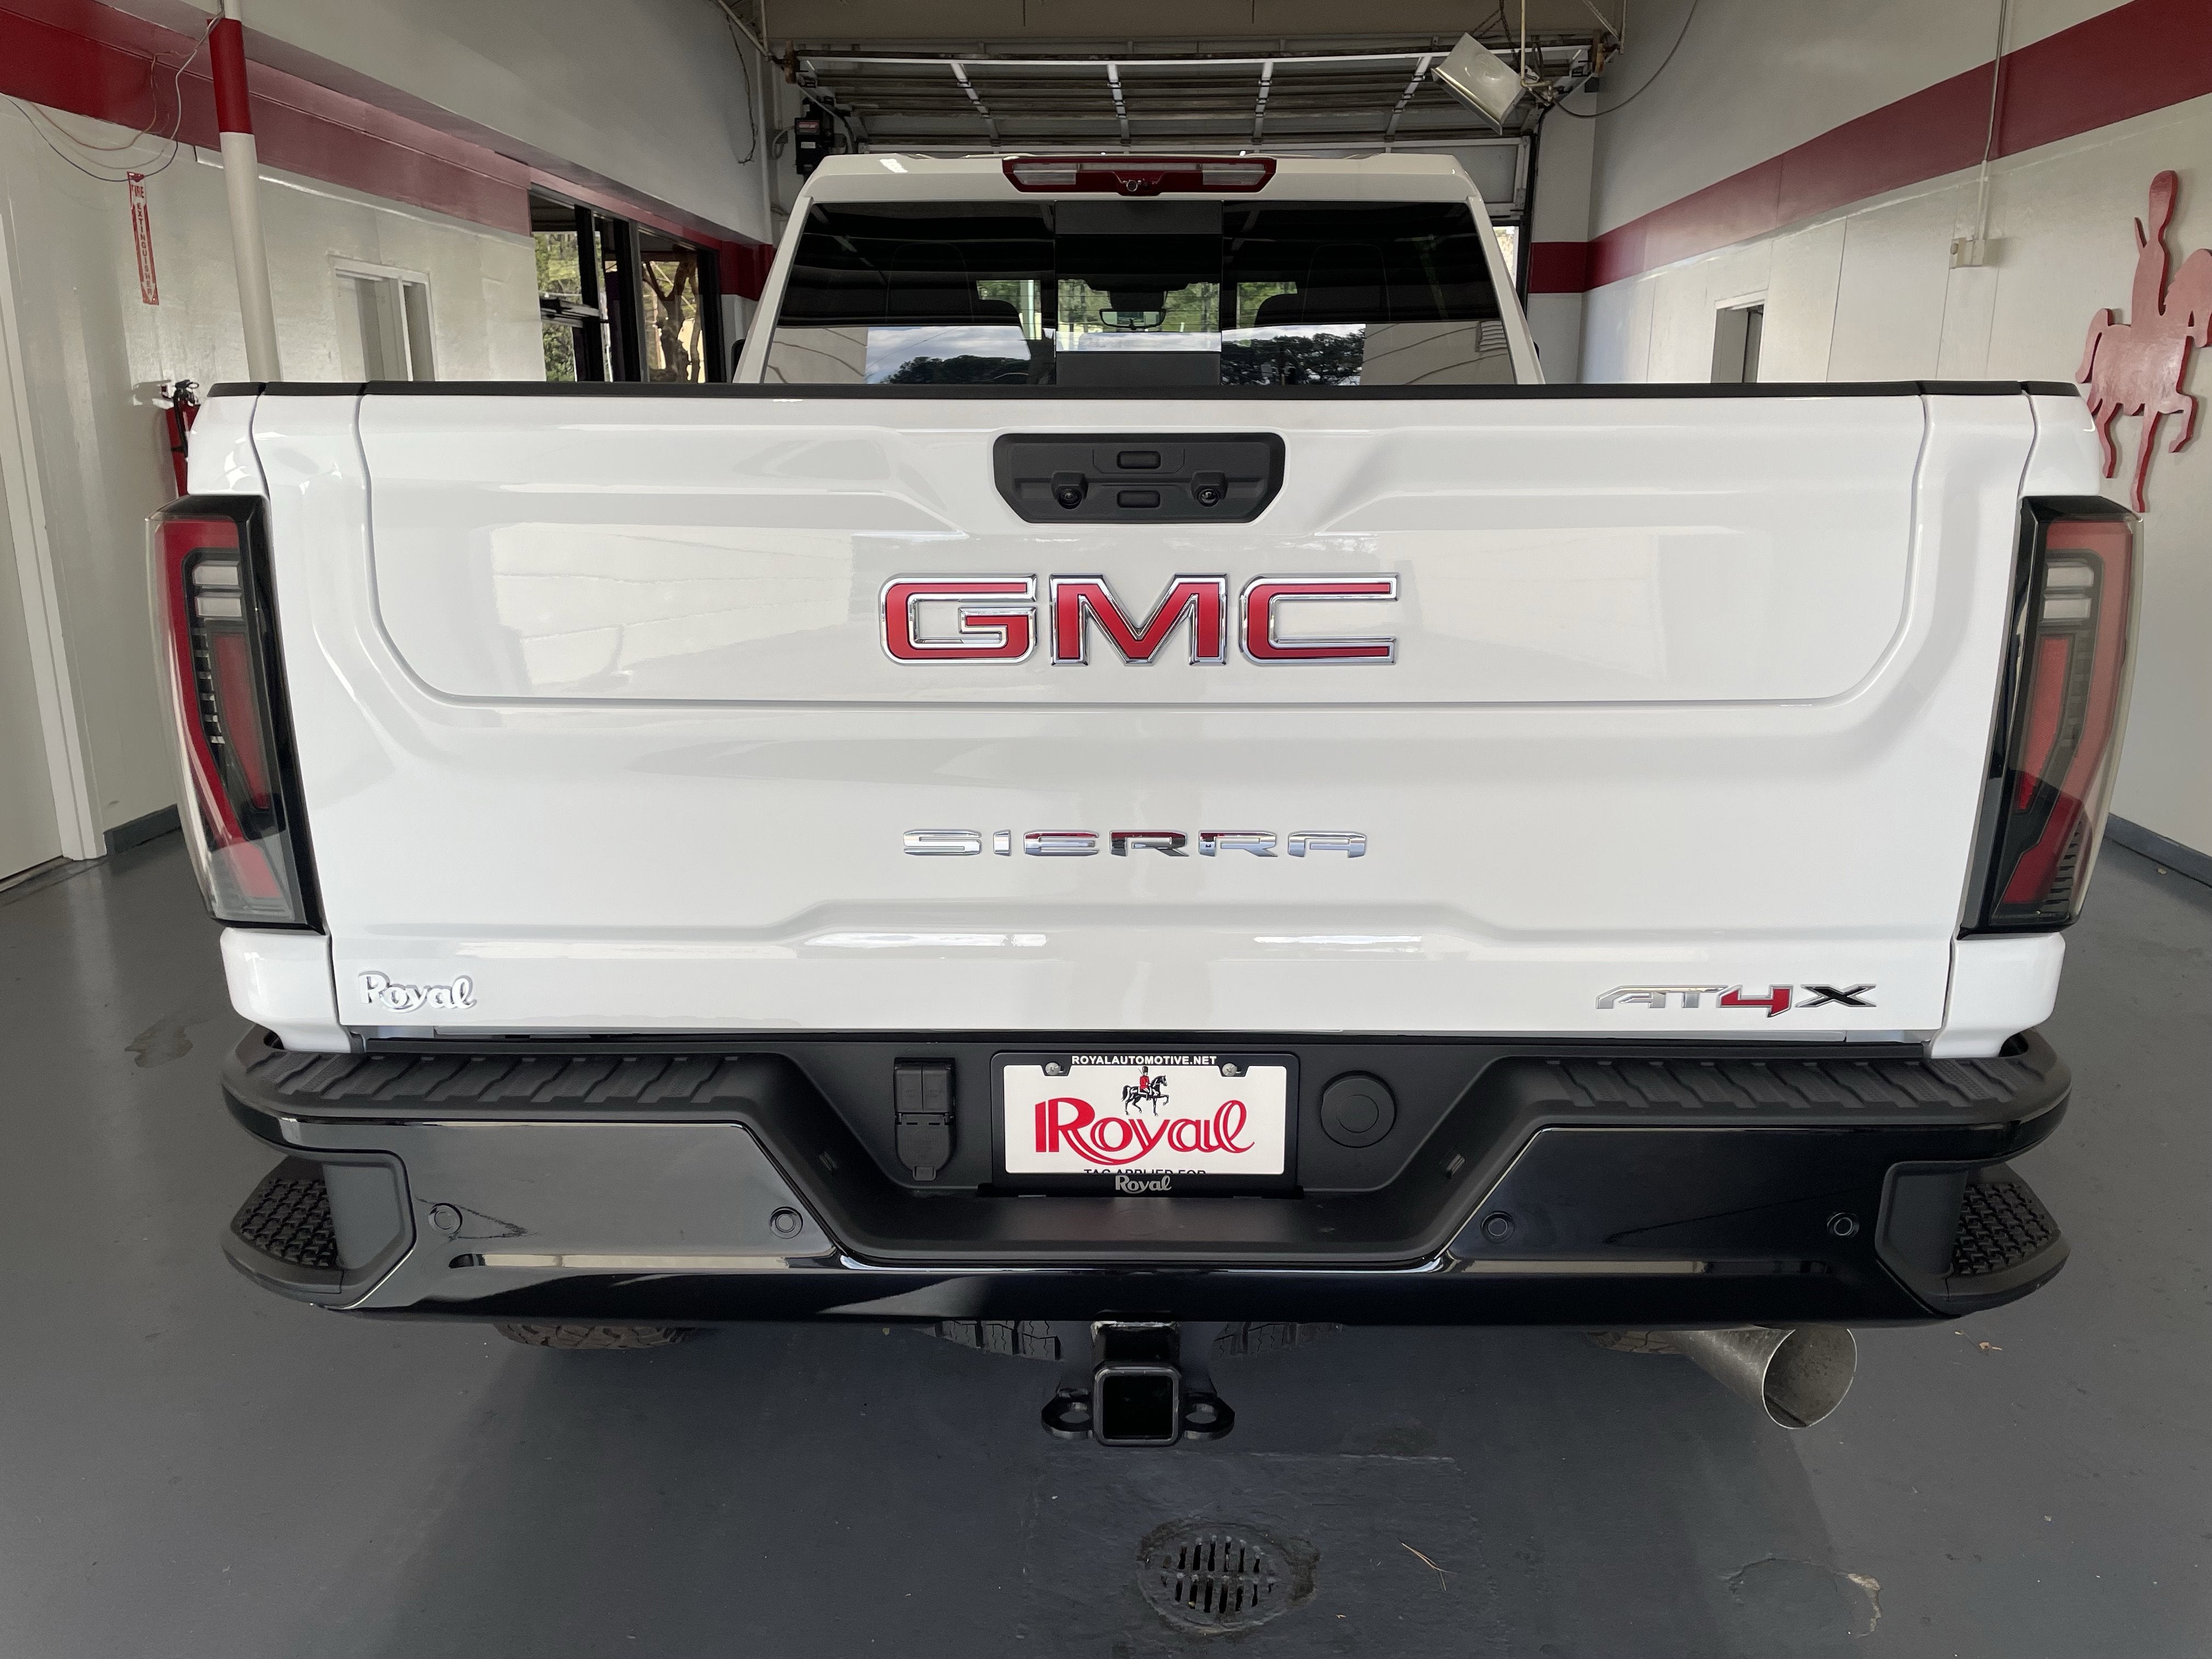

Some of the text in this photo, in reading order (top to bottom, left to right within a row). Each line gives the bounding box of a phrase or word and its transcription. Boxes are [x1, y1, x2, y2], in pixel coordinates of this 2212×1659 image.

[131, 184, 145, 199] FIRE
[136, 202, 153, 296] EXTINGUISHER
[878, 572, 1401, 667] GMC
[902, 829, 1367, 858] SIERRA
[358, 970, 477, 1013] Royal
[1596, 983, 1877, 1018] AT4X
[1071, 1055, 1217, 1065] ROYALAUTOMOTIVE.NET
[1035, 1097, 1255, 1166] Royal
[1115, 1175, 1172, 1194] Royal
